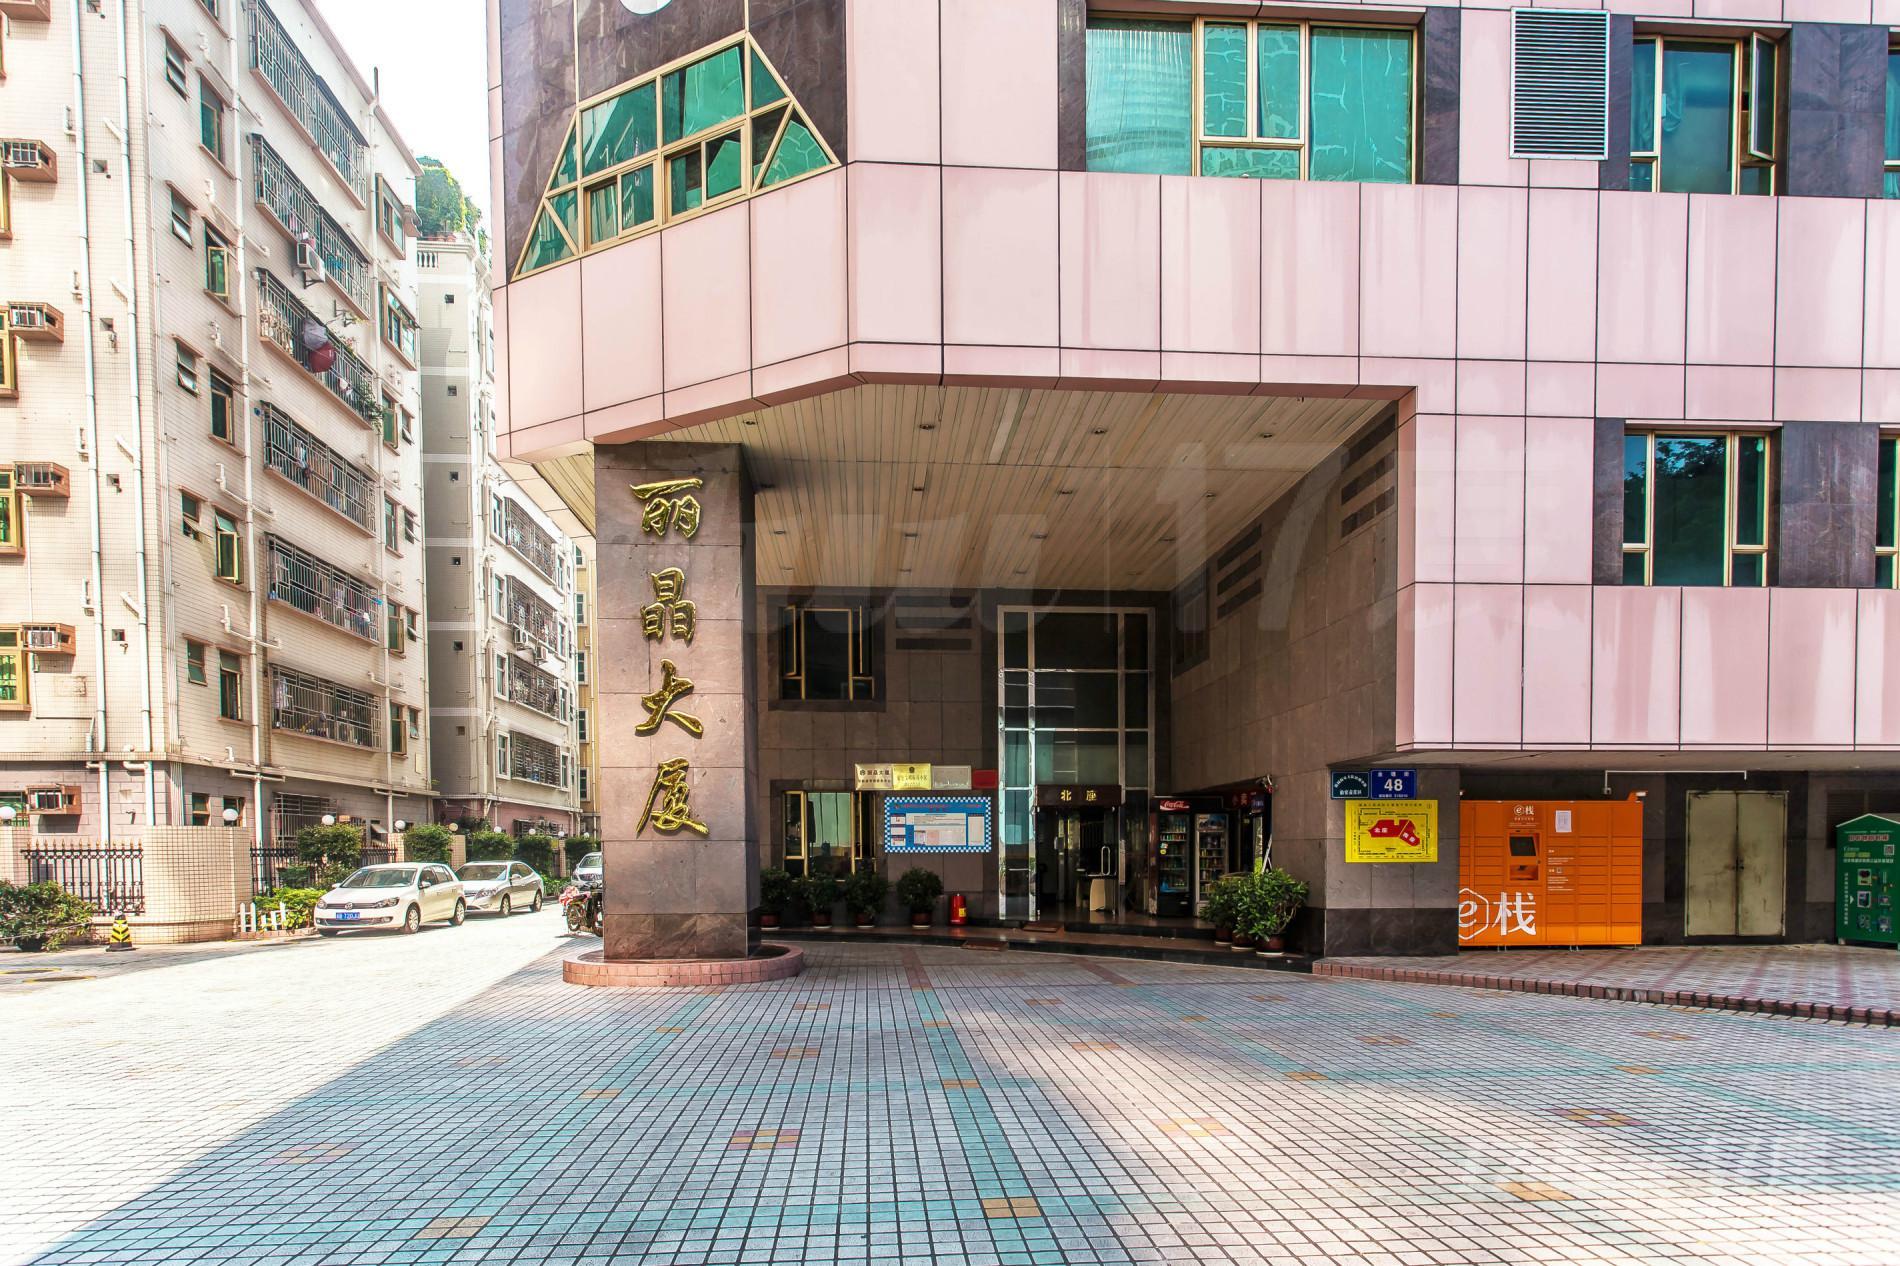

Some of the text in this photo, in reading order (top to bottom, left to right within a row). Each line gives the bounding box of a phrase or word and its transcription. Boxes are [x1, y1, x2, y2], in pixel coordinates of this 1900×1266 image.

[629, 478, 710, 838] 丽晶大厦
[1384, 778, 1403, 791] 48
[1060, 789, 1097, 801] 北座
